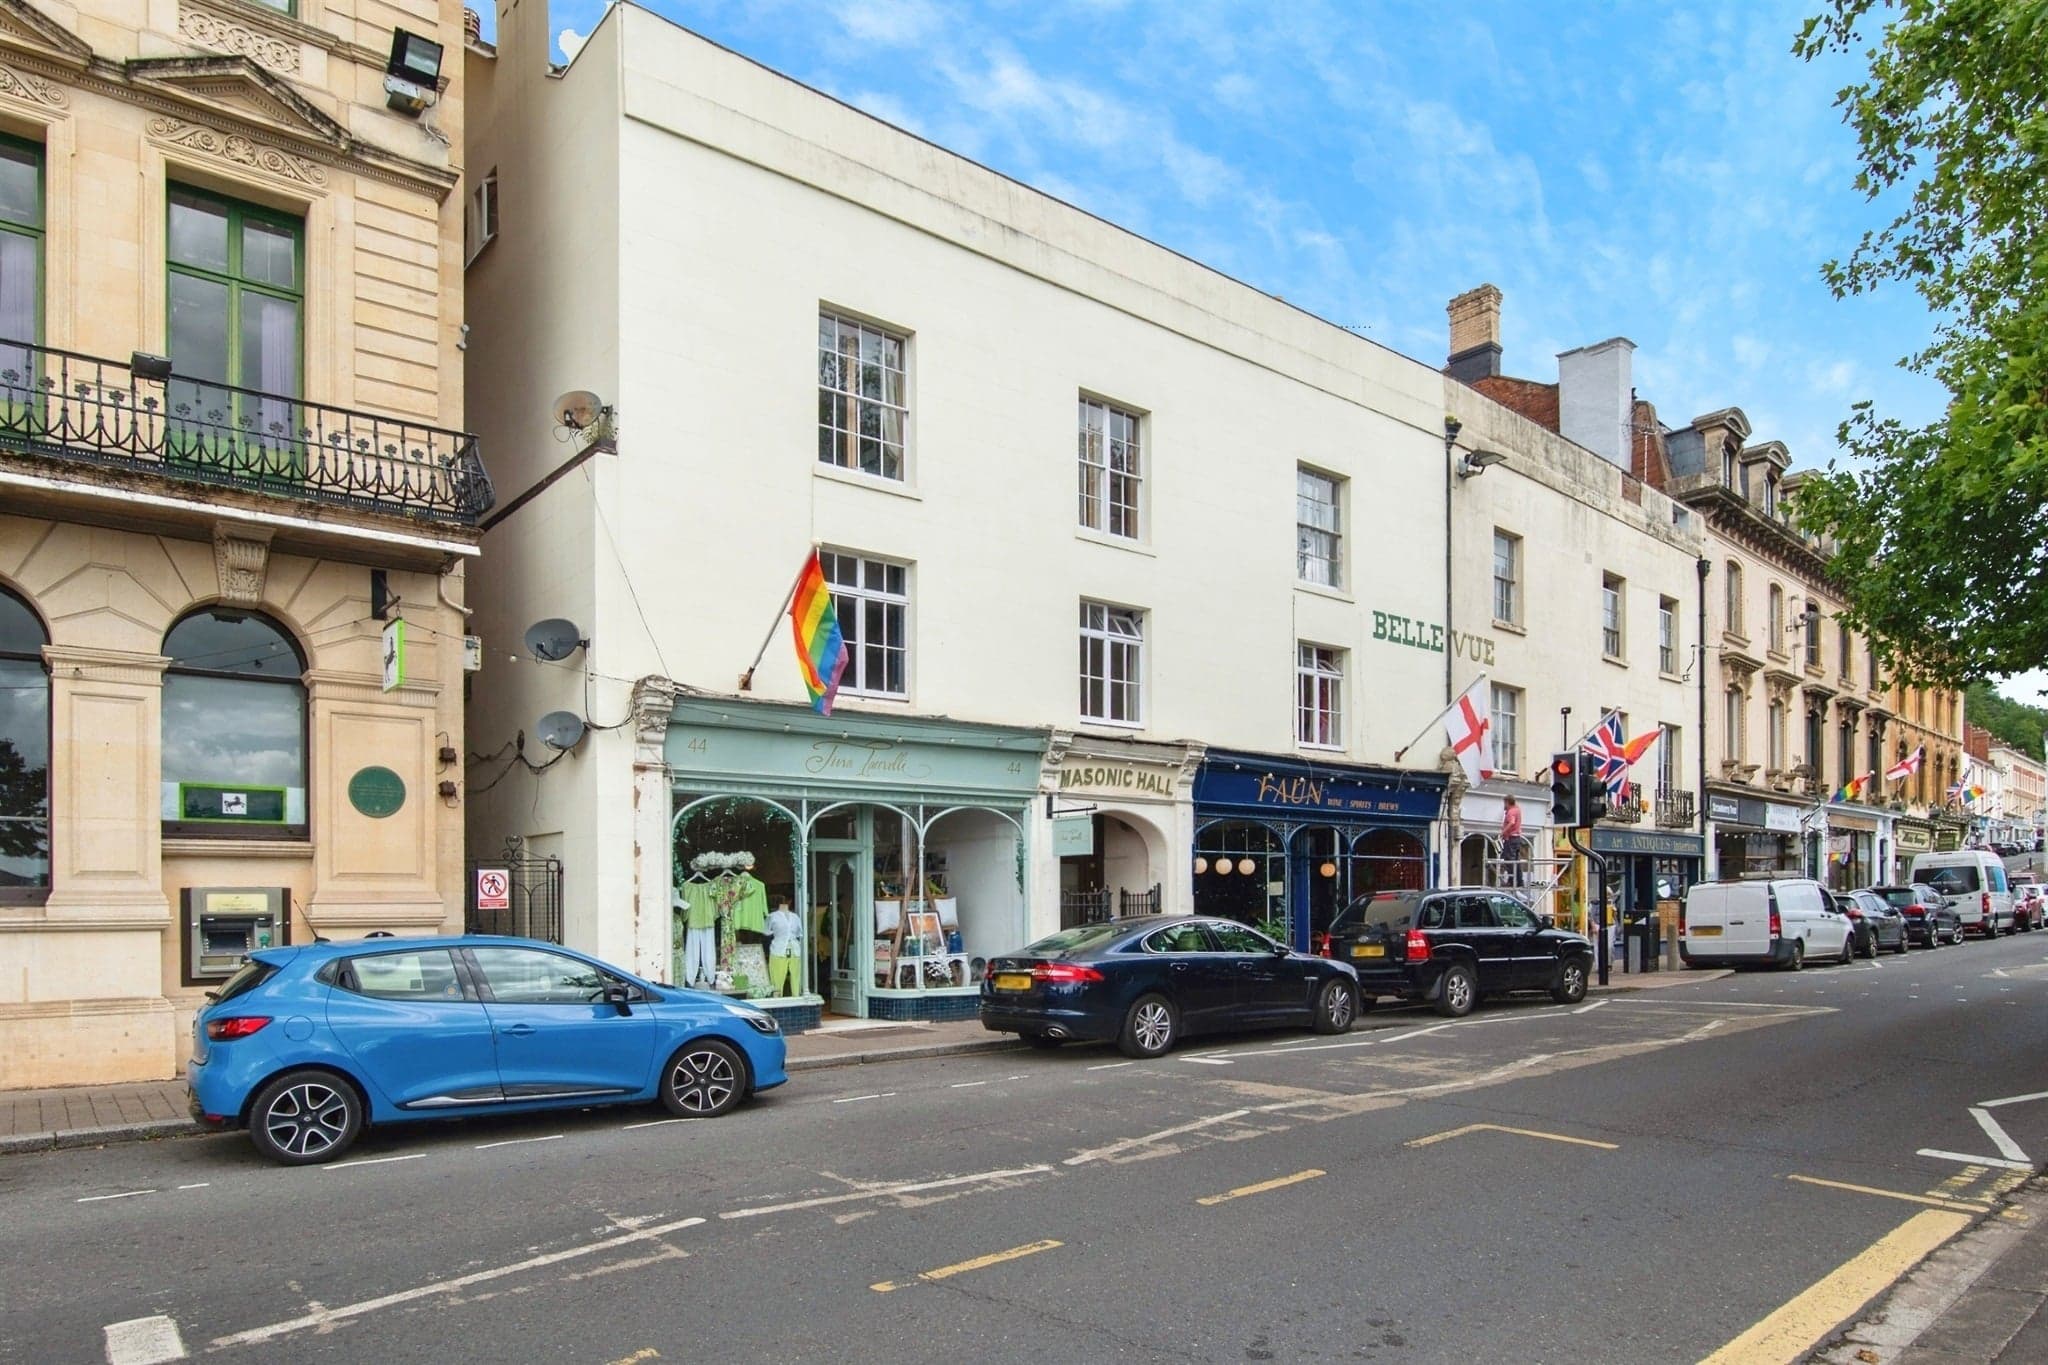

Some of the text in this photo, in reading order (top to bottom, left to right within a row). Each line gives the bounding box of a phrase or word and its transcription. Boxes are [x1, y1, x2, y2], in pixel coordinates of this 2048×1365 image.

[1372, 610, 1495, 667] BELLE VUE
[687, 737, 707, 752] 44
[1007, 761, 1023, 775] 44
[1060, 767, 1174, 796] MASONIC HALL
[1256, 775, 1325, 806] FAUN
[1630, 836, 1671, 851] ANTIQUES
